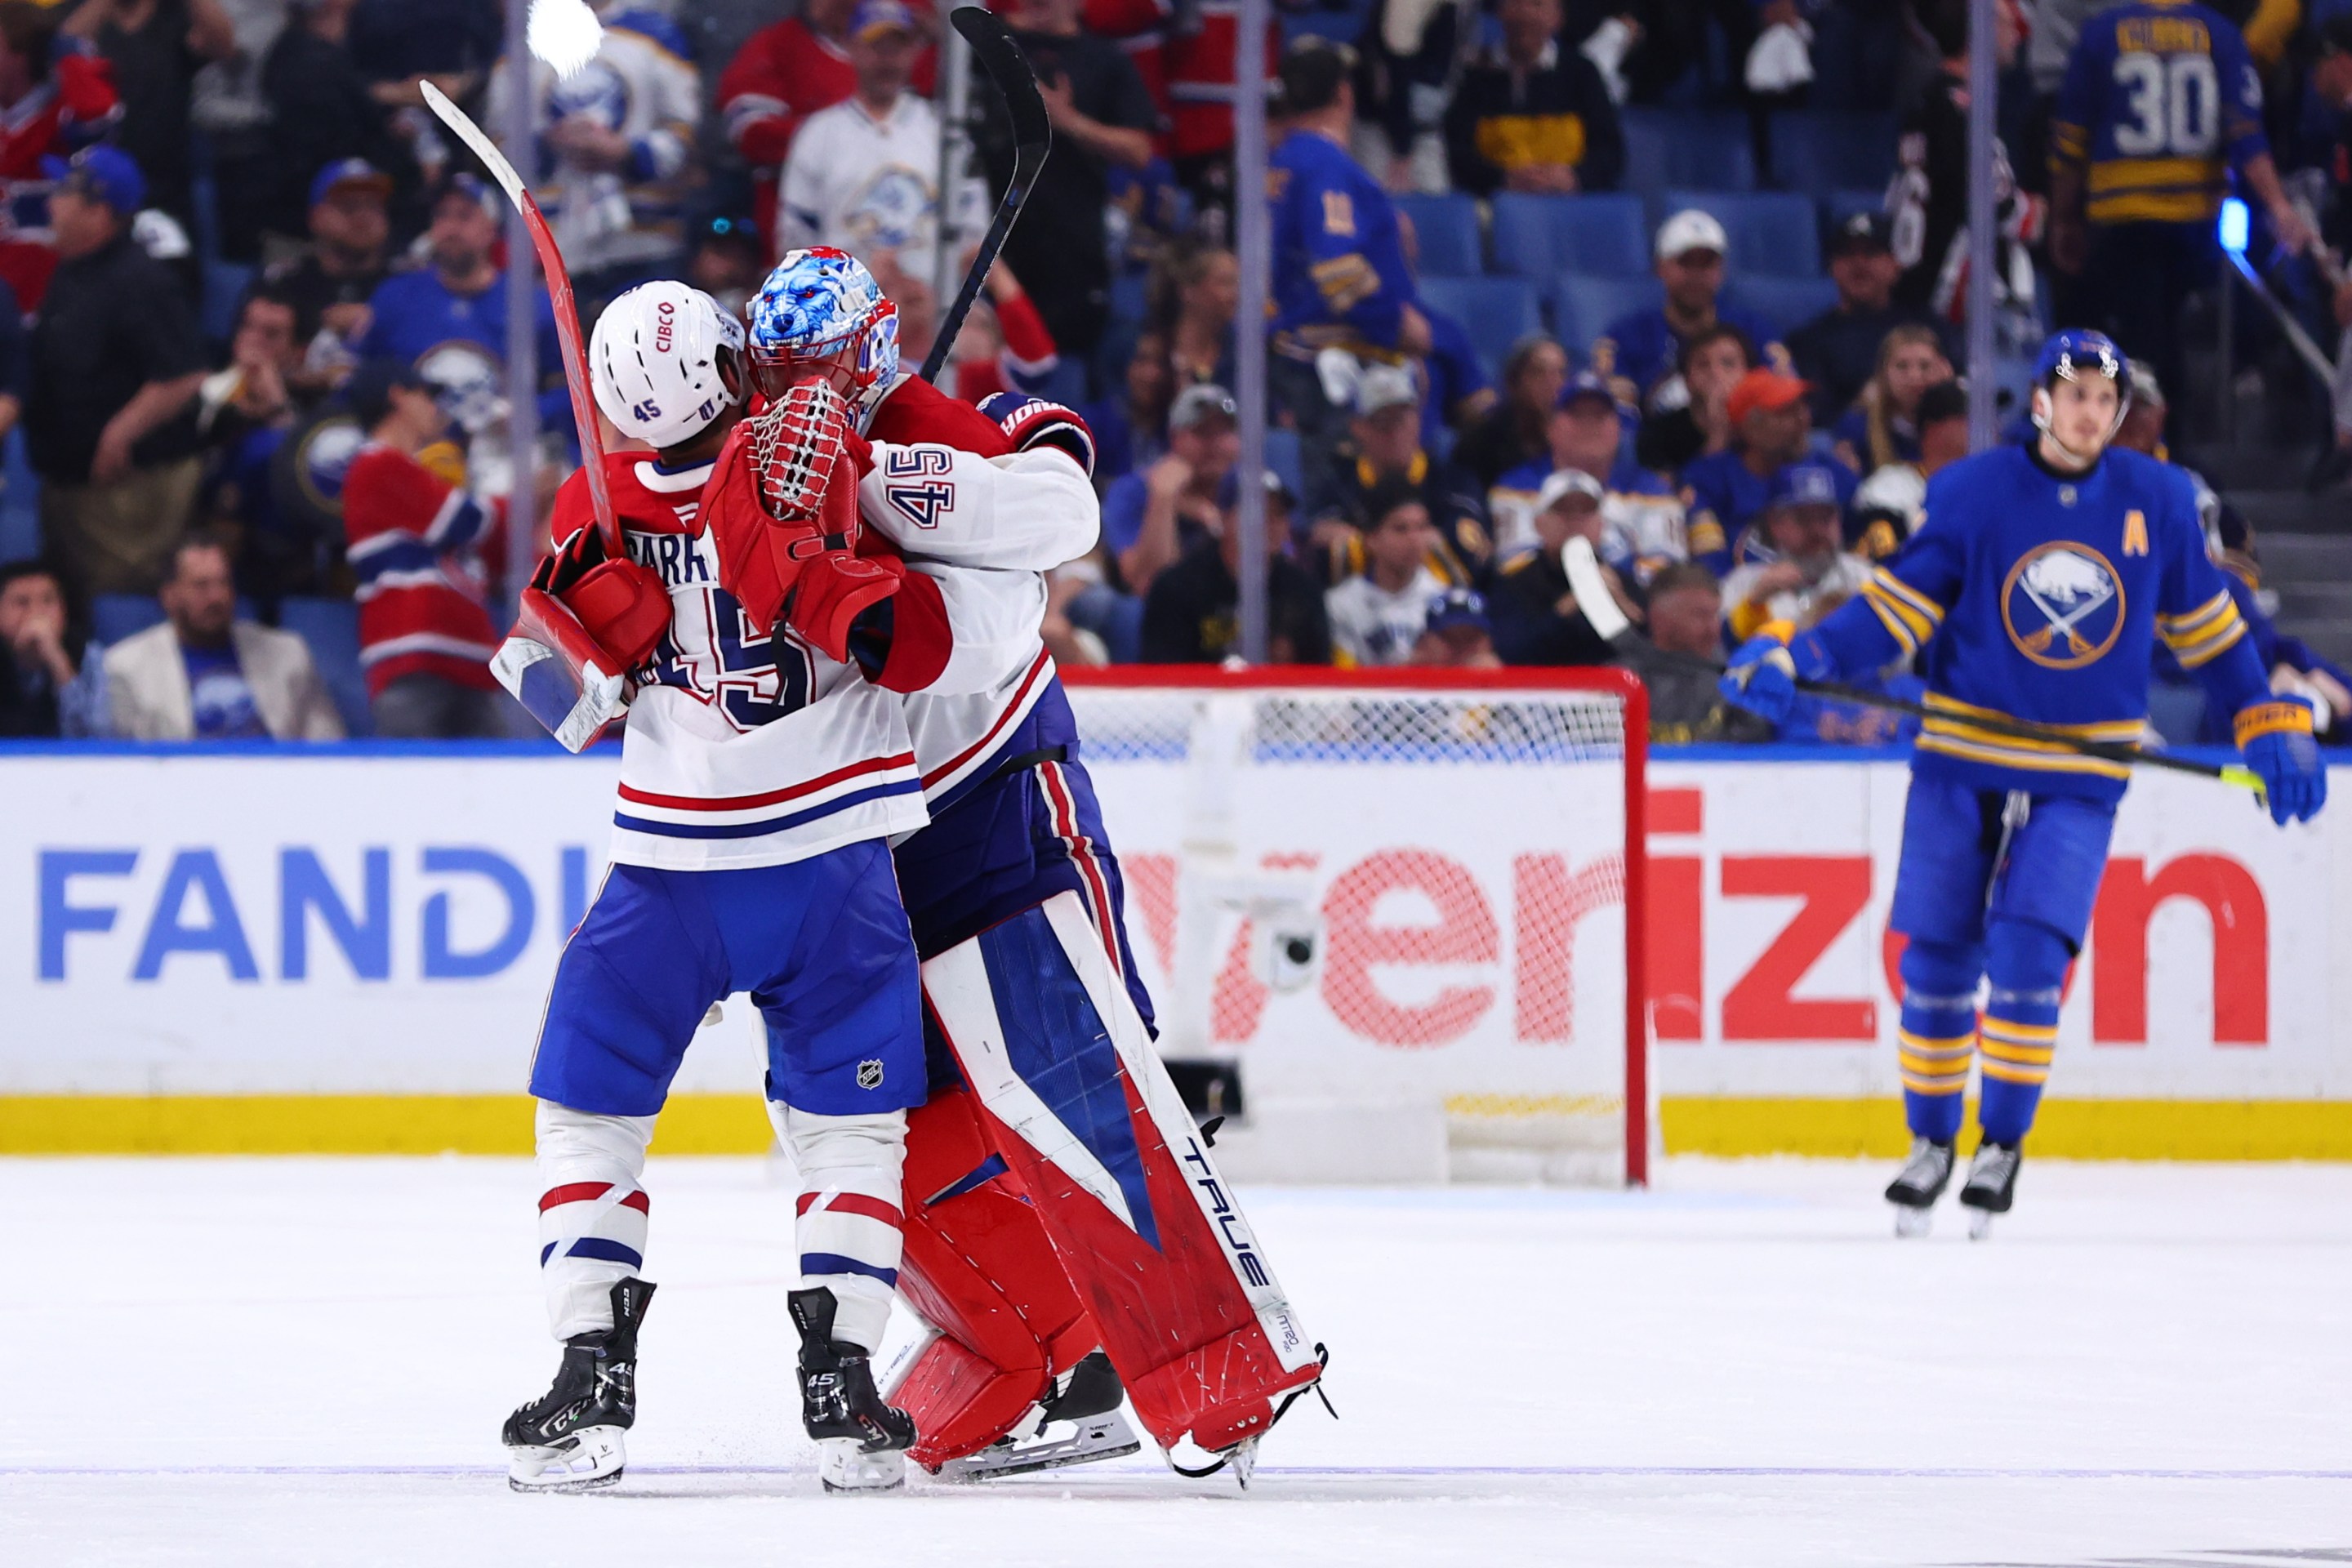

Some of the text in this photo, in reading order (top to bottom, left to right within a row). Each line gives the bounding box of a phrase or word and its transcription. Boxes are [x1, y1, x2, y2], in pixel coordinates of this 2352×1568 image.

[2113, 51, 2220, 155] 30
[656, 315, 674, 353] CIBC
[633, 398, 662, 422] 45
[885, 449, 955, 529] 45
[2122, 509, 2149, 557] A
[626, 533, 718, 587] ARR
[1122, 788, 2268, 1049] verizn
[1184, 1136, 1270, 1287] TRUE
[794, 1303, 808, 1330] CCM
[807, 1372, 836, 1388] 45
